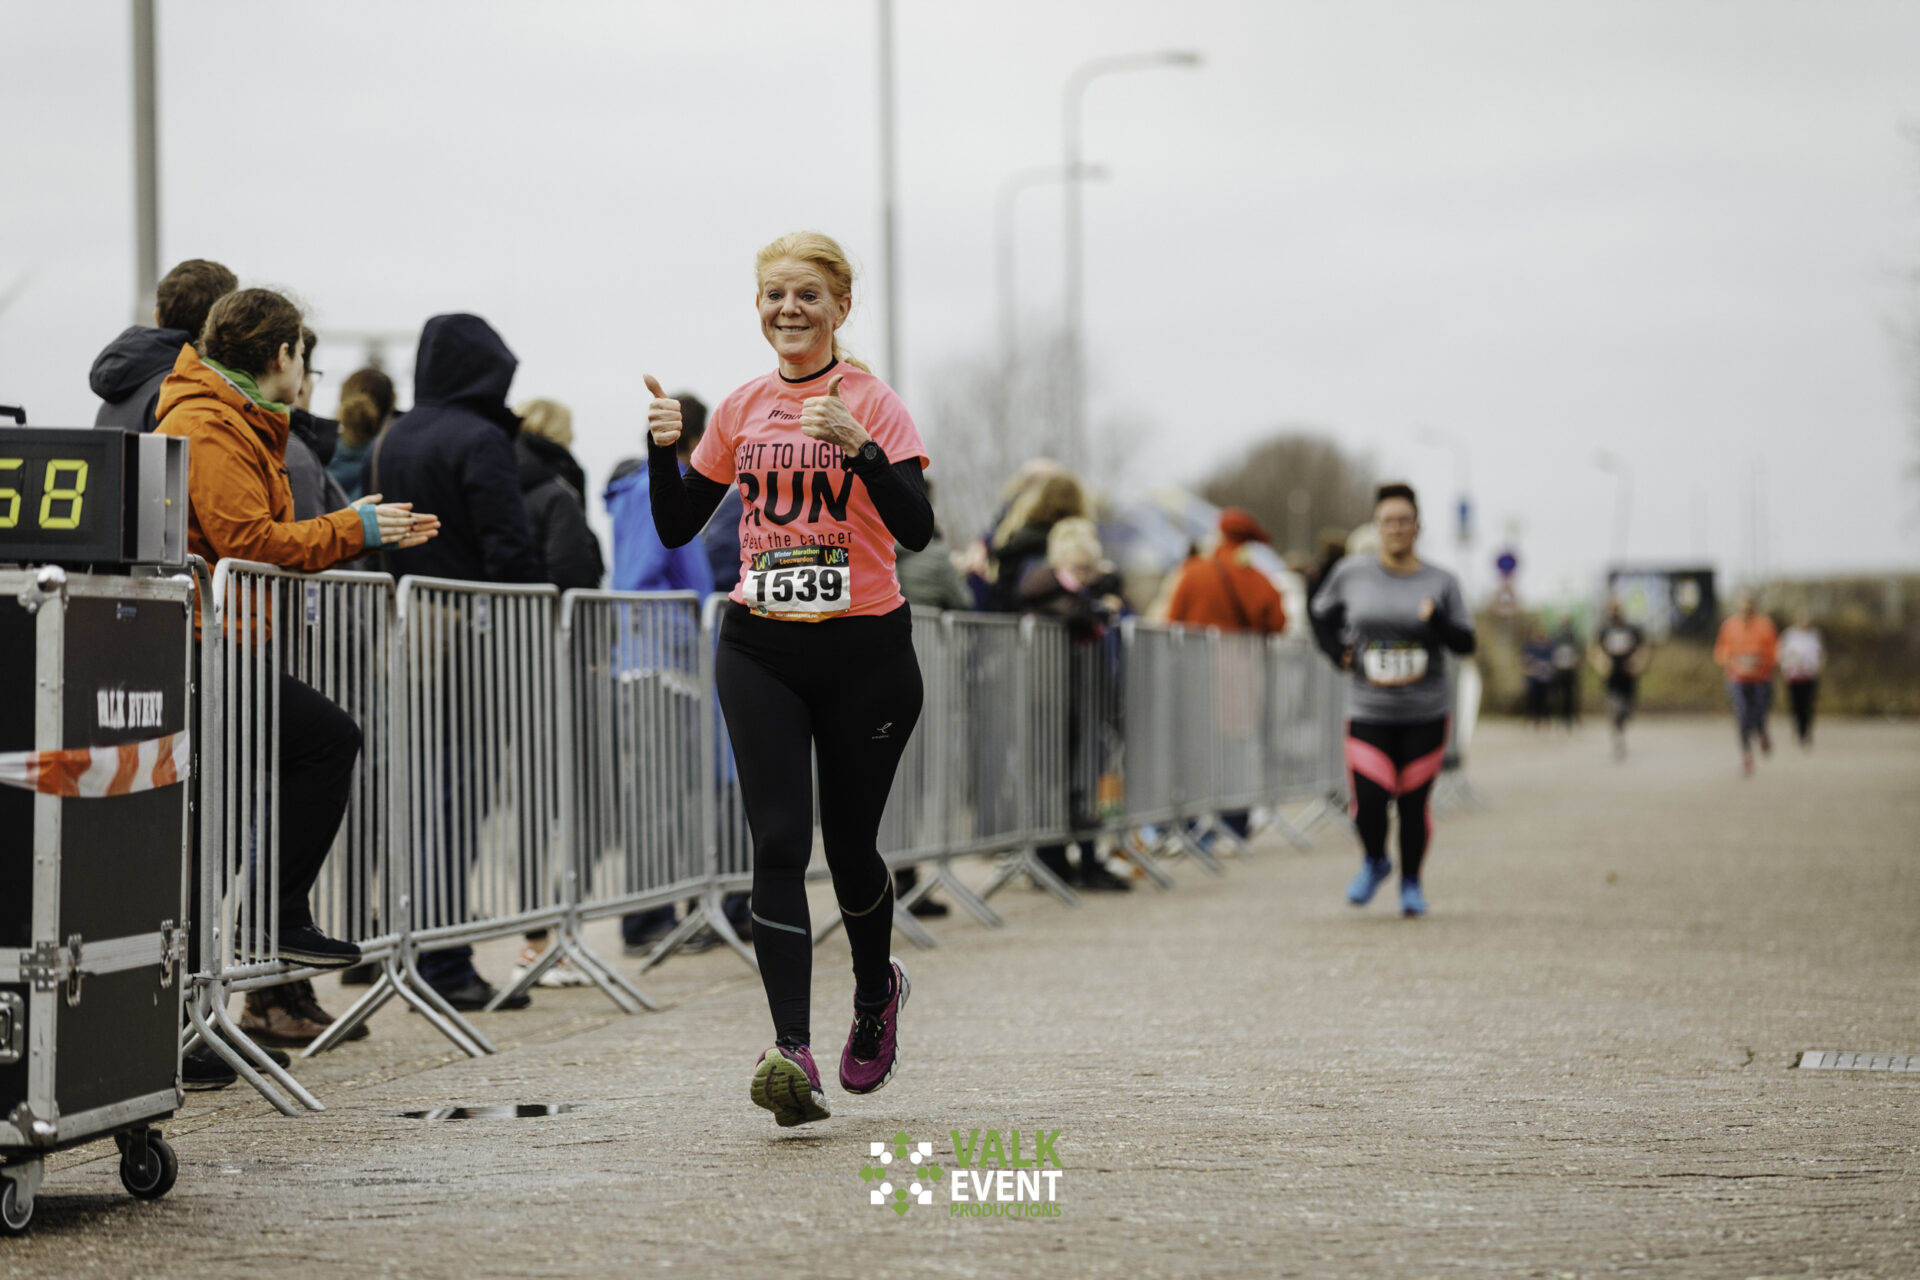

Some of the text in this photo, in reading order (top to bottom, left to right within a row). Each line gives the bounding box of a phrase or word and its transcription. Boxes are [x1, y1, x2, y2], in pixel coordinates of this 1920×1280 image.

[772, 443, 794, 469] TO
[801, 443, 845, 469] LIGH
[739, 471, 854, 526] RUN
[768, 532, 791, 547] the
[800, 532, 852, 545] cancer
[792, 548, 820, 556] Marathon
[752, 569, 842, 602] 1539
[128, 690, 163, 728] EVENT
